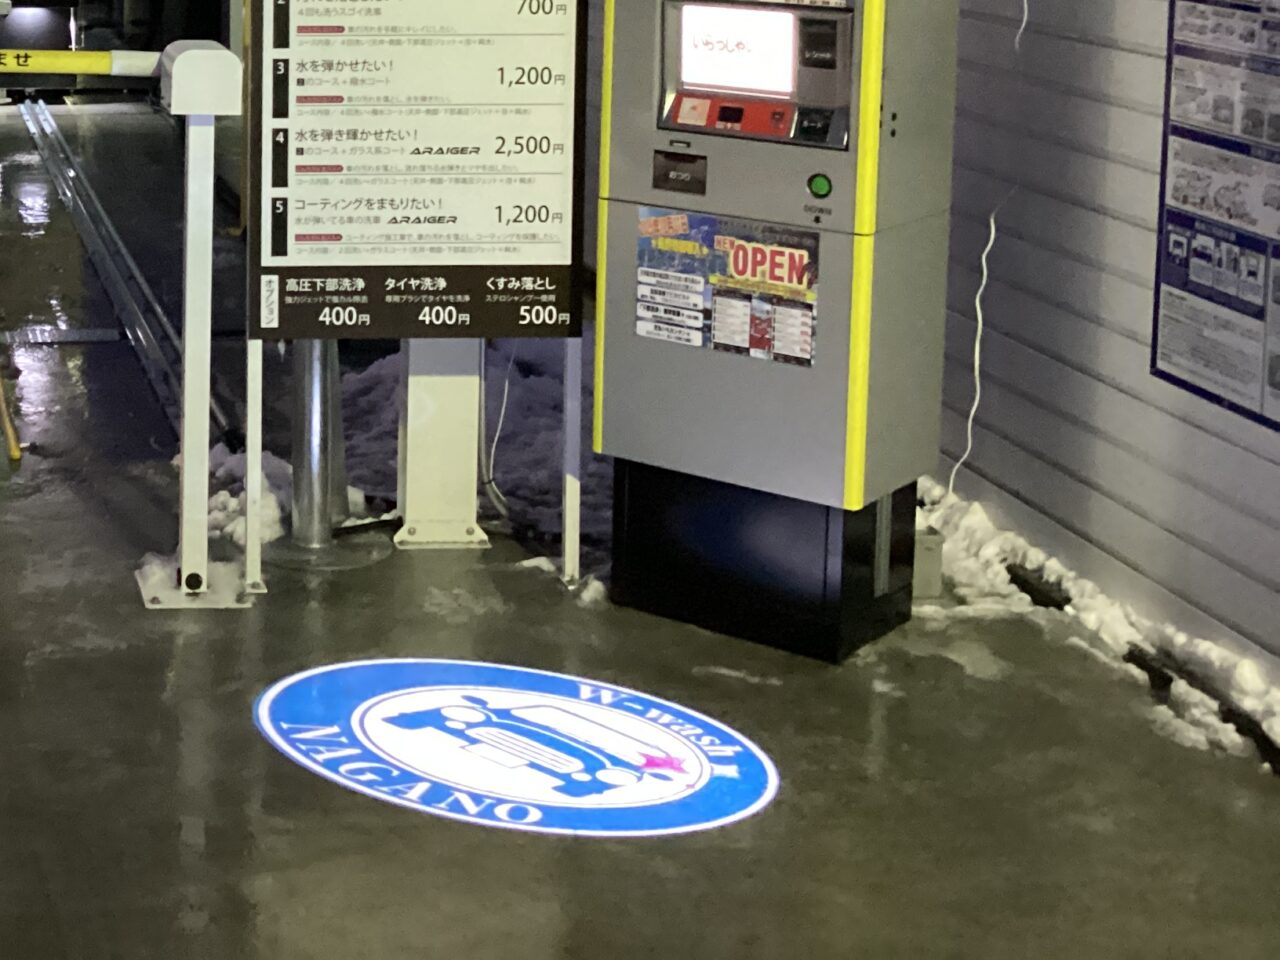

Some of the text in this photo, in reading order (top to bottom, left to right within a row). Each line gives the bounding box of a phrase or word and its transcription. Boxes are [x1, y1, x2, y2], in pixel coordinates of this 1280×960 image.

[277, 62, 285, 74] 3
[497, 67, 566, 87] 1,200円
[275, 131, 284, 144] 4
[409, 147, 480, 155] ARAIGER
[494, 136, 564, 157] 2,500円
[275, 201, 284, 213] 5
[494, 205, 563, 225] 1,200円
[387, 216, 458, 224] ARAIGER
[733, 244, 808, 286] OPEN
[285, 278, 556, 292] 高圧下部洗浄 タイヤ洗浄 くすみ落とし
[318, 305, 570, 326] 400円 400円 500円
[280, 720, 544, 826] NAGANO
